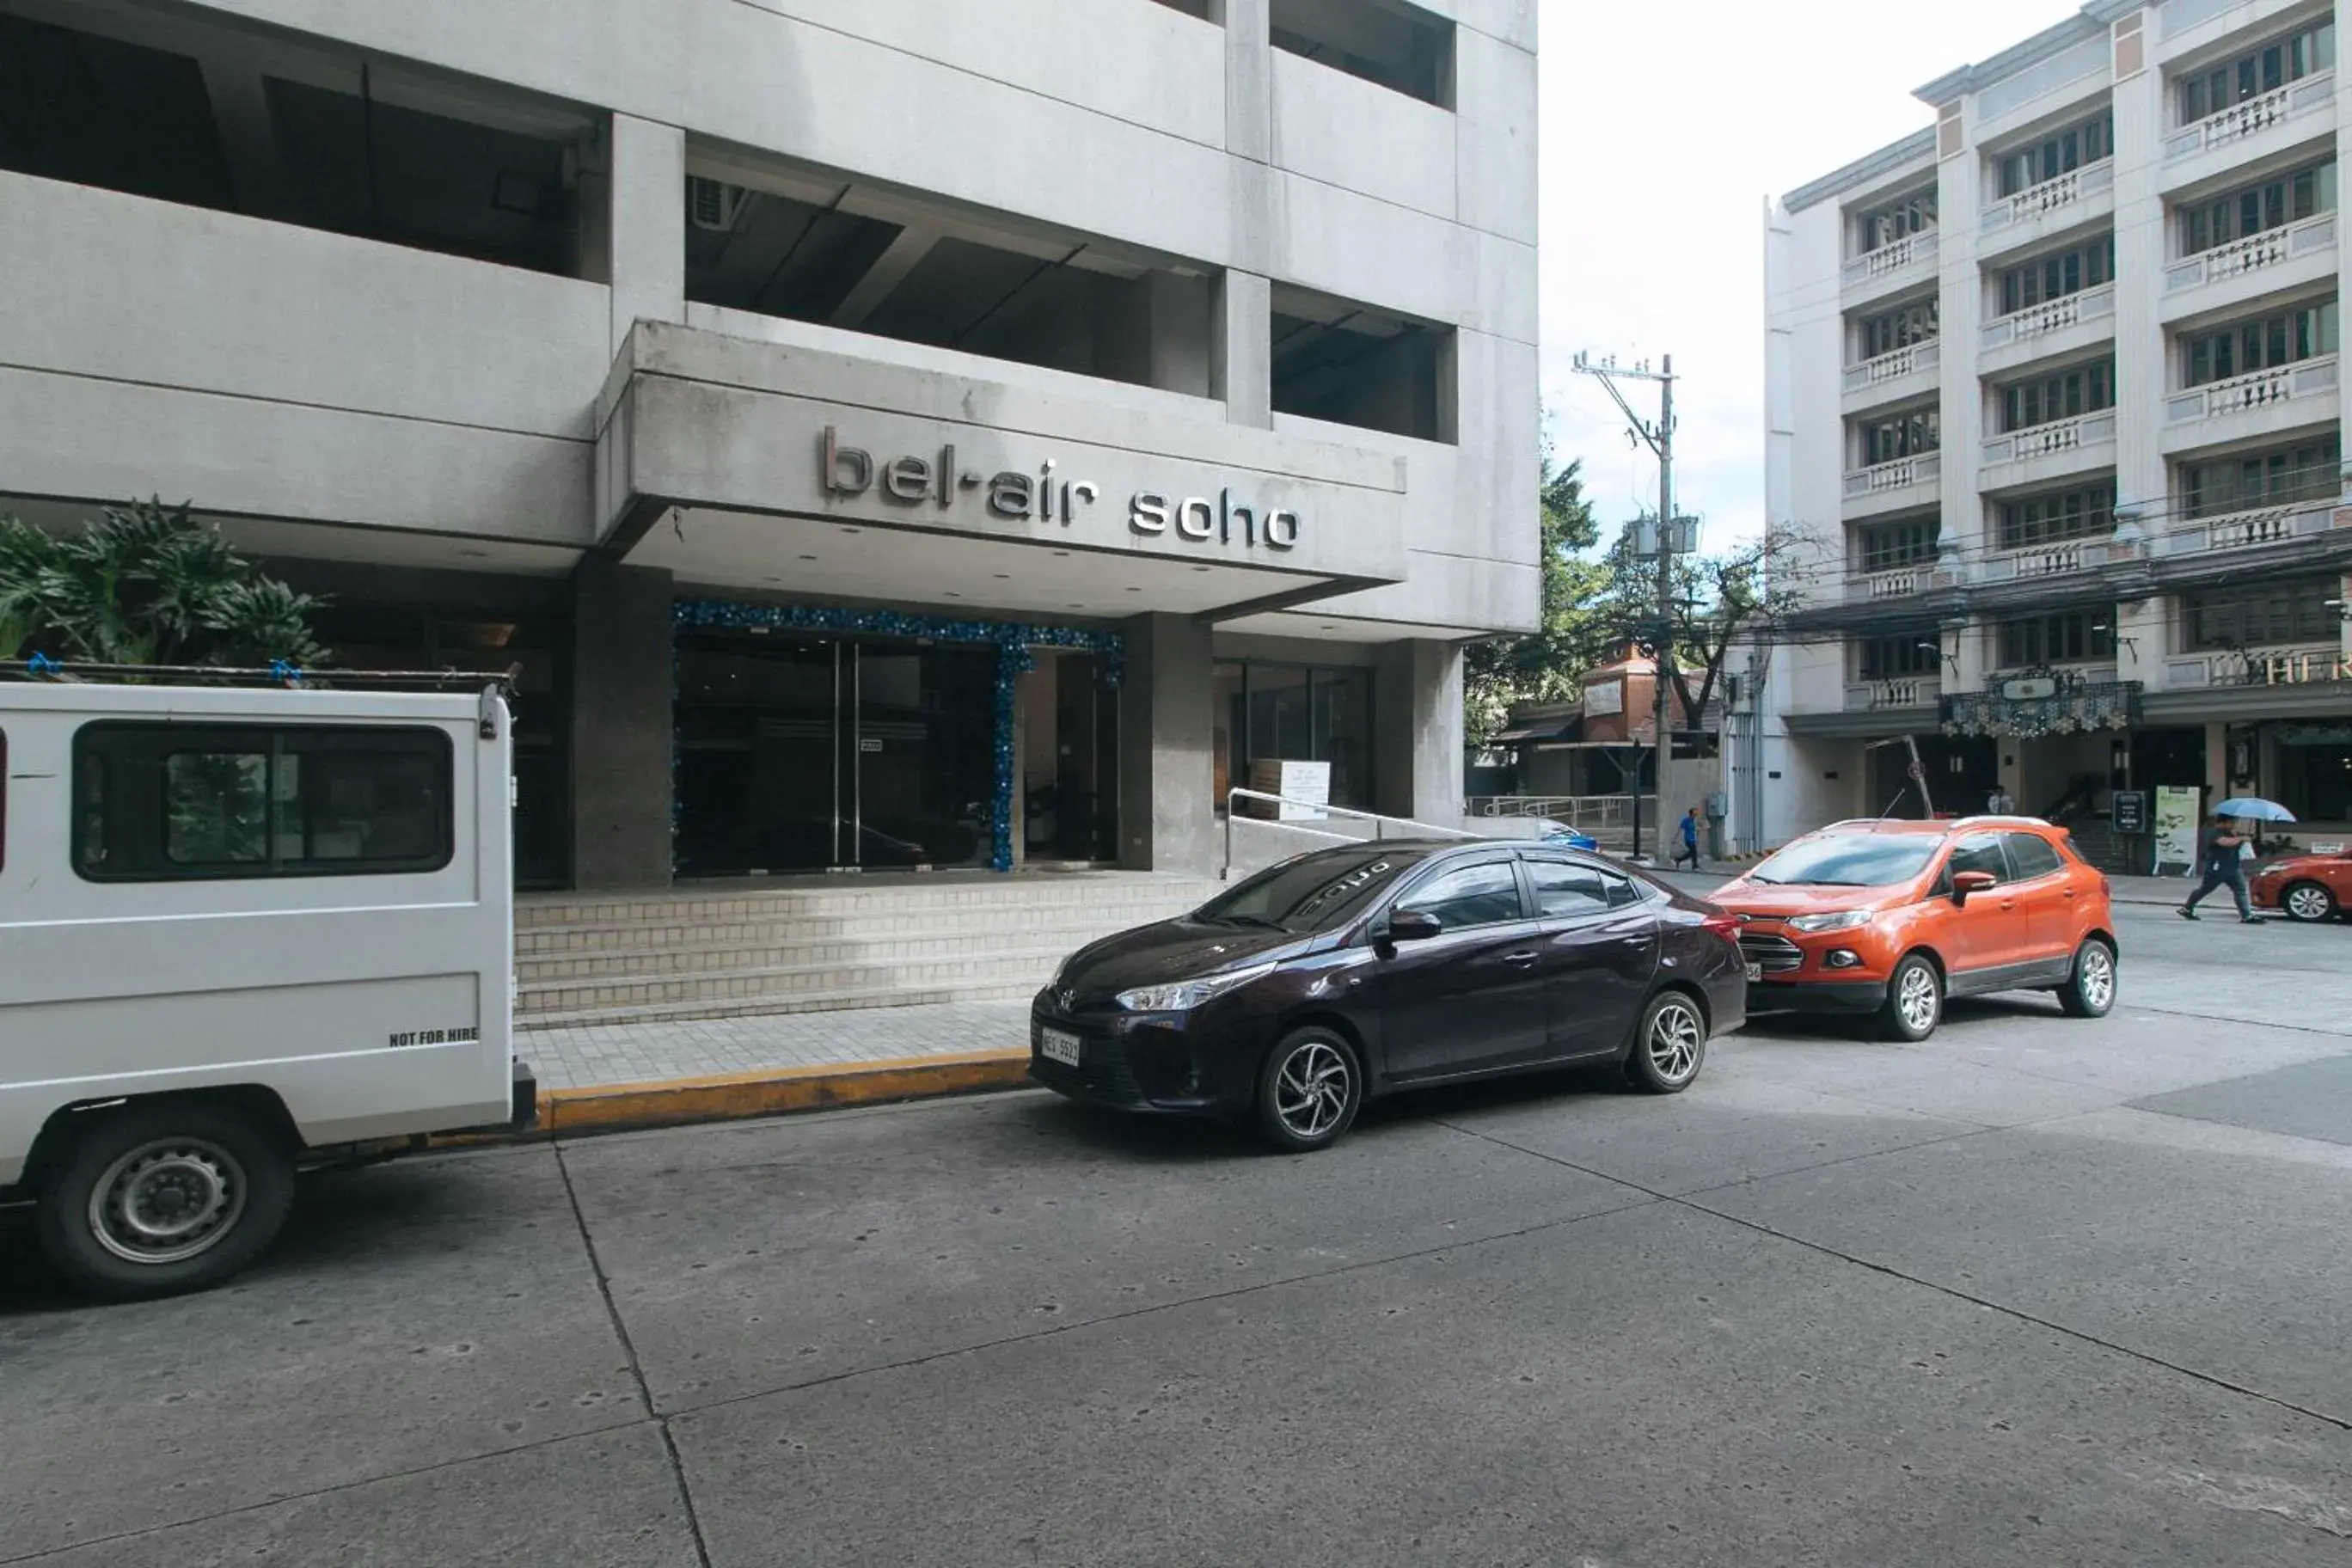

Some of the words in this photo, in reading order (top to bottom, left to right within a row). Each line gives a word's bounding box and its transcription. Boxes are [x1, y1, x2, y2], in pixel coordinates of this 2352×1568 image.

[1129, 487, 1300, 550] soho
[389, 1032, 414, 1047] NOT
[420, 1030, 444, 1044] FOR
[448, 1026, 479, 1042] HIRE
